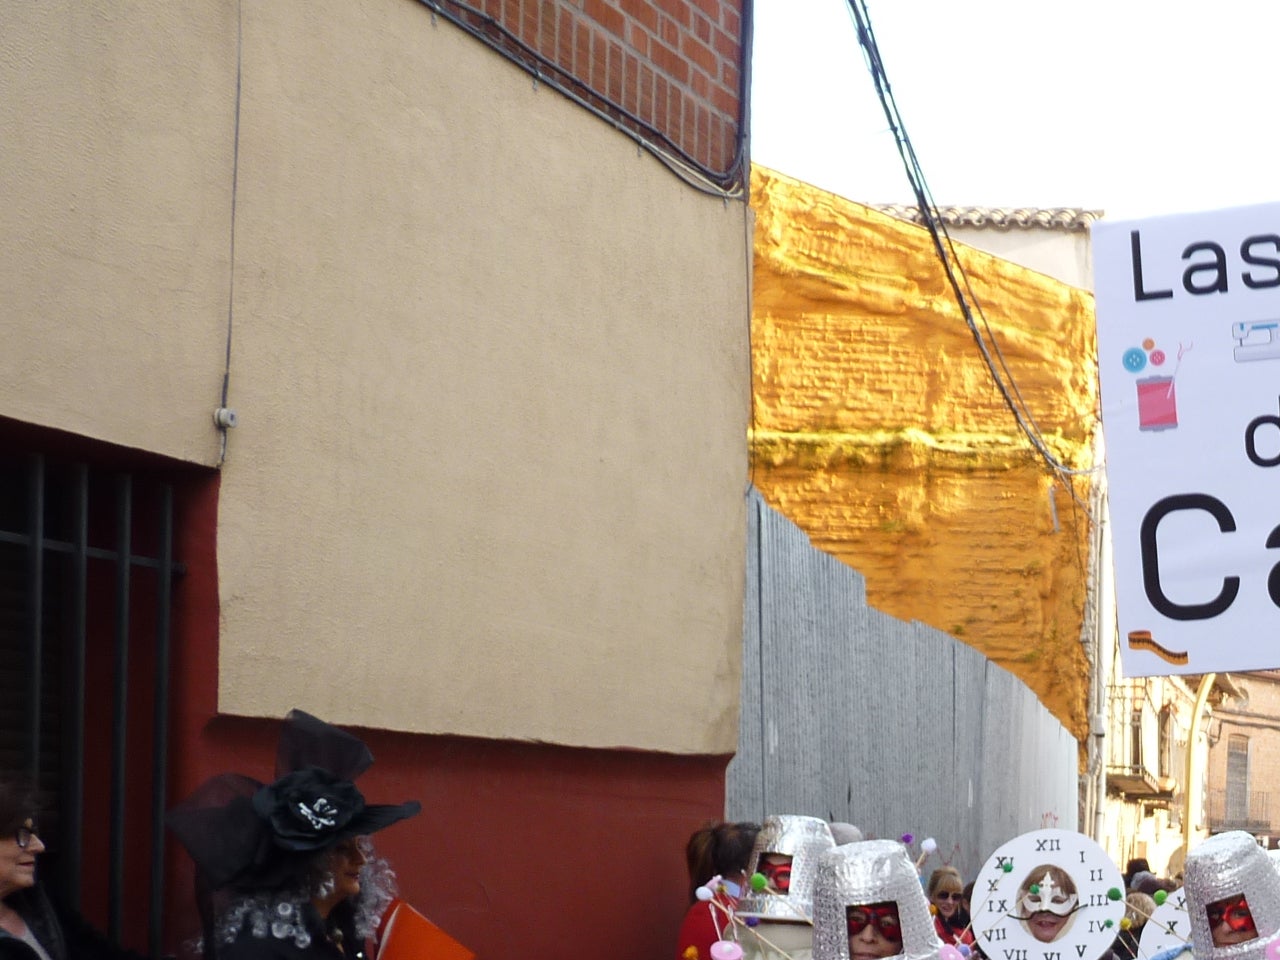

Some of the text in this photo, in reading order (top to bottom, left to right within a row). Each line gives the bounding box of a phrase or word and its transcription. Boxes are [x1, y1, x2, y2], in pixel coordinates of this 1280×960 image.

[1035, 839, 1061, 851] XII
[1080, 851, 1086, 863] I
[1090, 869, 1103, 881] II
[988, 879, 999, 891] X
[988, 900, 1008, 912] IX
[1090, 894, 1109, 907] III
[1089, 920, 1107, 933] IV
[982, 928, 1006, 942] VII
[1076, 945, 1087, 957] V
